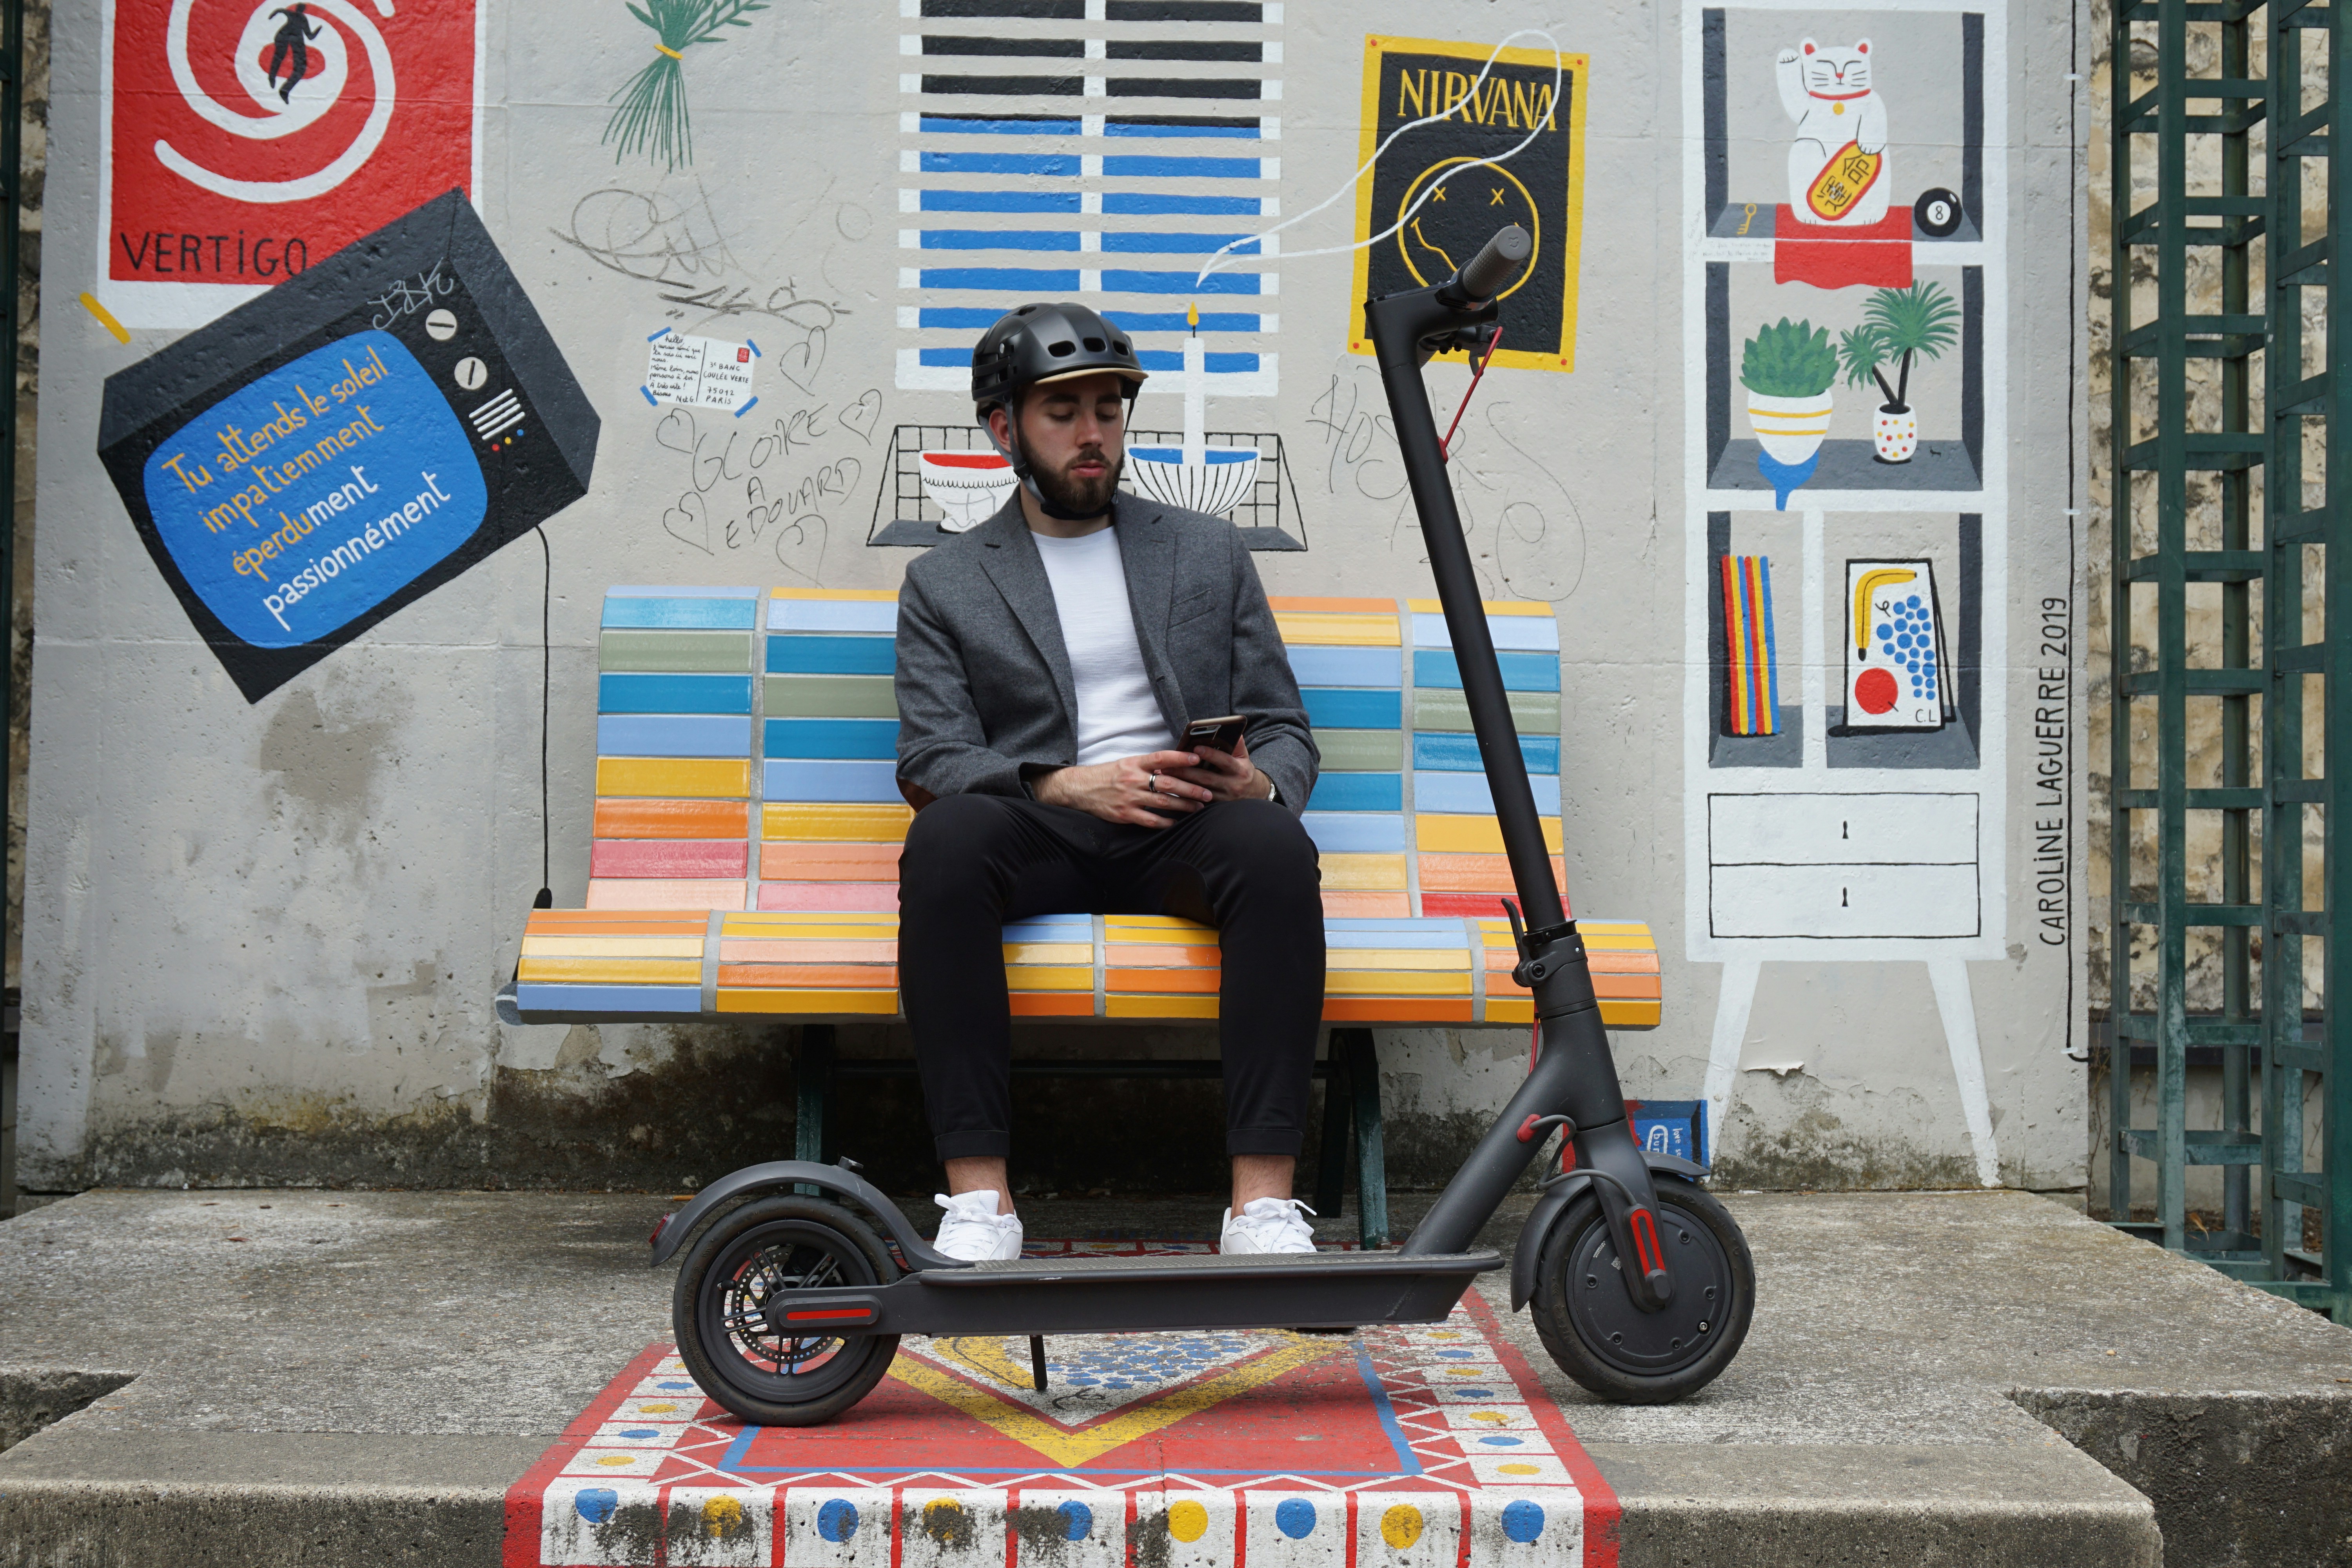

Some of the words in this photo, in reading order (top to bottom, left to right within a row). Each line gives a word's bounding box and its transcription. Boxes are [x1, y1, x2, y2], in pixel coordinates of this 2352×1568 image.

[1397, 69, 1557, 131] NIRVANA
[1936, 205, 1944, 220] 8
[703, 371, 728, 380] COULÉE
[731, 374, 749, 383] VERTE
[707, 386, 735, 396] 75012
[162, 453, 213, 493] Tu
[216, 401, 307, 473] attends
[295, 385, 330, 417] le
[330, 345, 390, 404] soleil
[198, 405, 385, 534] impatiemment
[747, 476, 766, 505] A
[232, 465, 379, 582] éperdument
[726, 457, 861, 549] EDOUARD
[263, 471, 451, 632] passionnément
[2041, 598, 2067, 657] 2019
[2036, 668, 2065, 806] LAGUERRE
[1673, 1128, 1683, 1144] love
